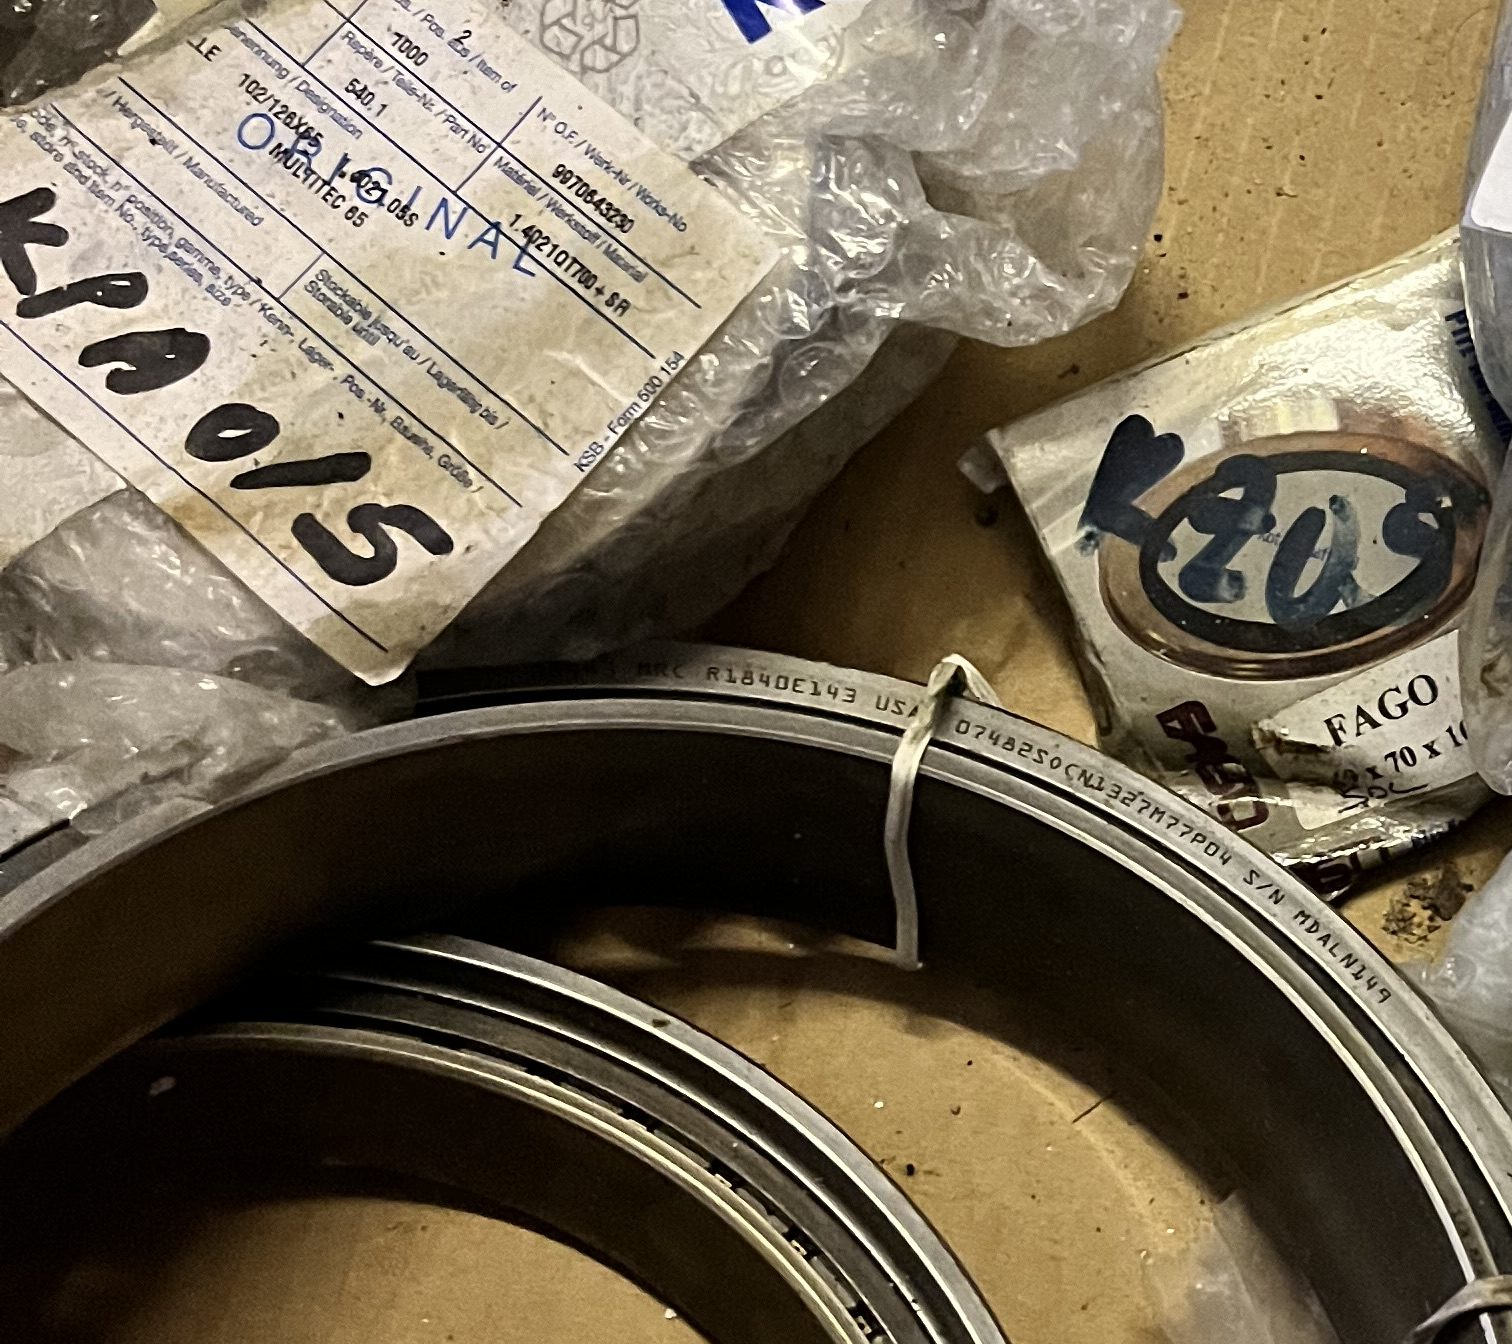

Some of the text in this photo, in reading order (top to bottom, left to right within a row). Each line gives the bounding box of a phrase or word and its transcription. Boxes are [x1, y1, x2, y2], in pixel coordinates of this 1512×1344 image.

[387, 29, 430, 68] 1000
[343, 76, 388, 118] 540.1
[236, 110, 542, 279] ORIGINAL
[267, 140, 347, 211] MULTITEC
[571, 438, 606, 473] KSB
[605, 398, 642, 436] Form
[657, 347, 687, 377] 154
[1324, 673, 1441, 750] FAGO
[1382, 742, 1420, 776] 70
[1242, 867, 1284, 905] S/N
[1293, 906, 1393, 1005] MDALN149
